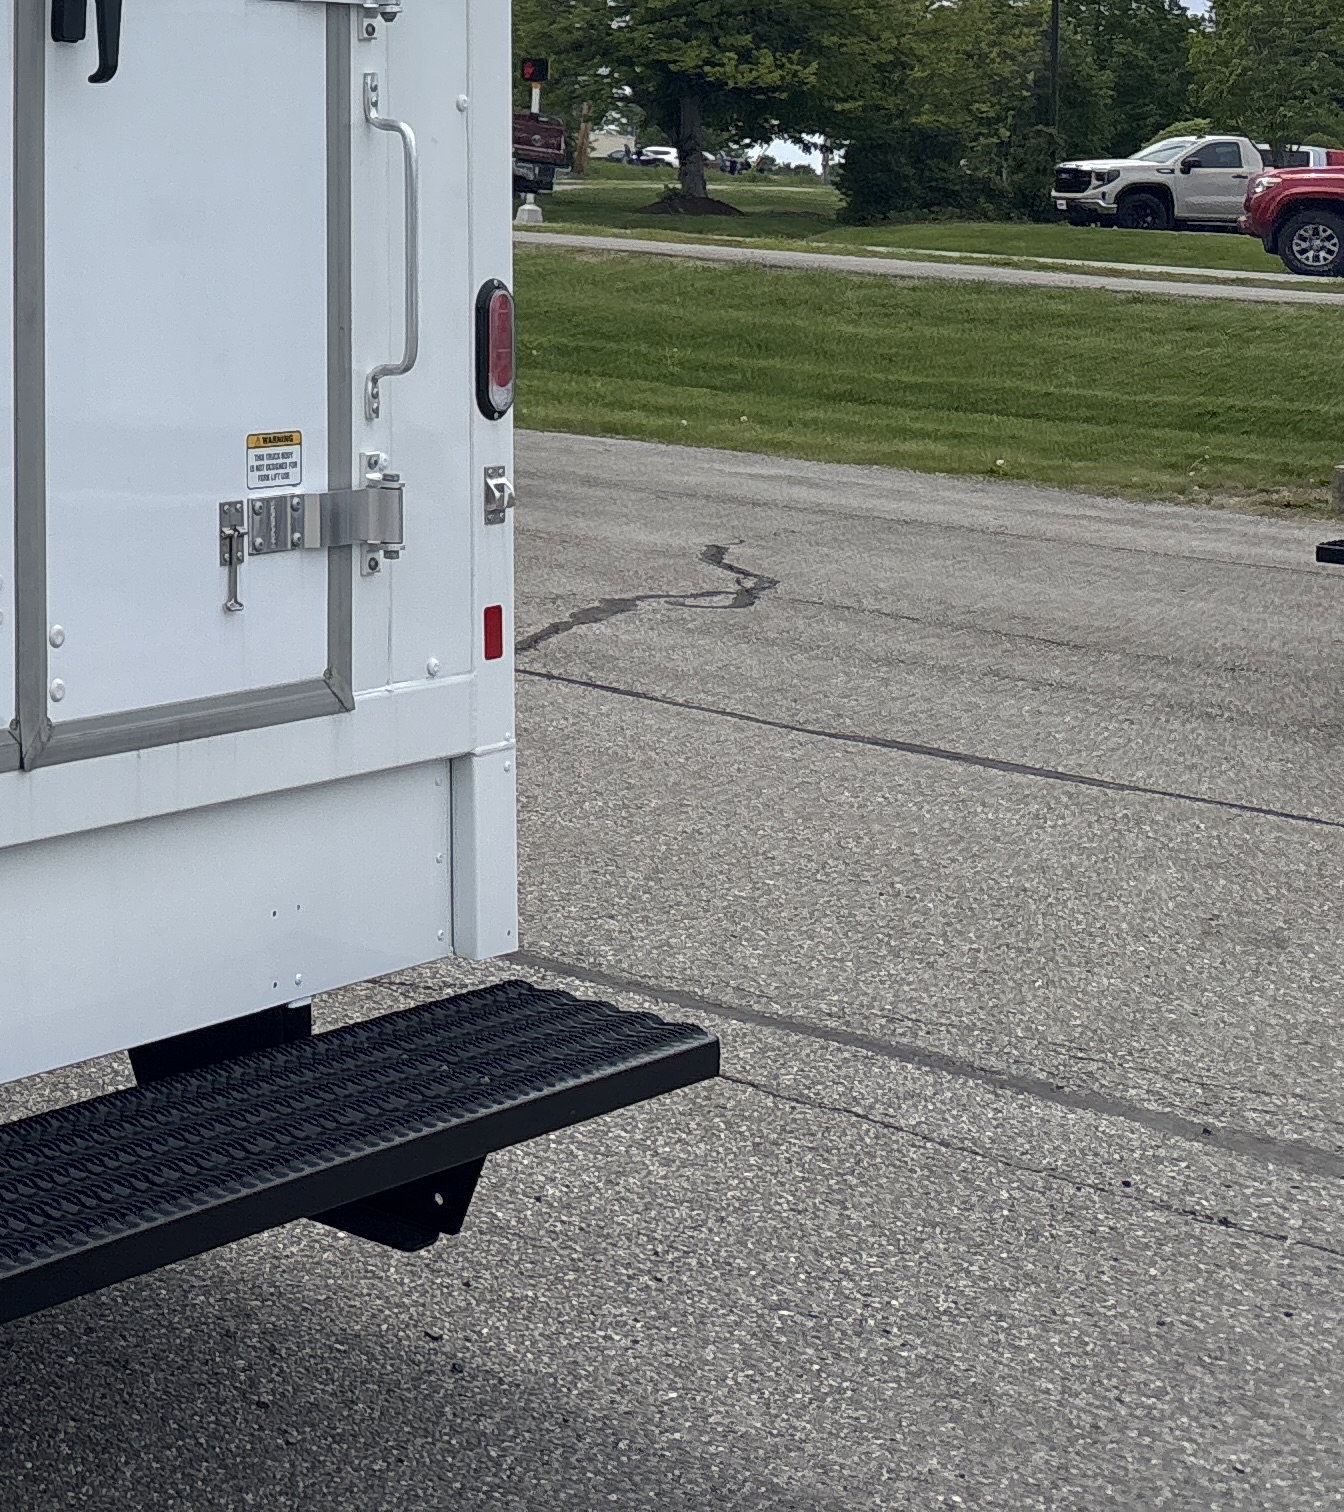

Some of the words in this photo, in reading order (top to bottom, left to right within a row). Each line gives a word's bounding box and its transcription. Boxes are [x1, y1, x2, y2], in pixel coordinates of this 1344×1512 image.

[262, 434, 293, 444] WARNING
[266, 452, 280, 460] TRUCK
[255, 463, 264, 471] NOT
[289, 461, 297, 469] FOR
[271, 472, 280, 481] LIFT
